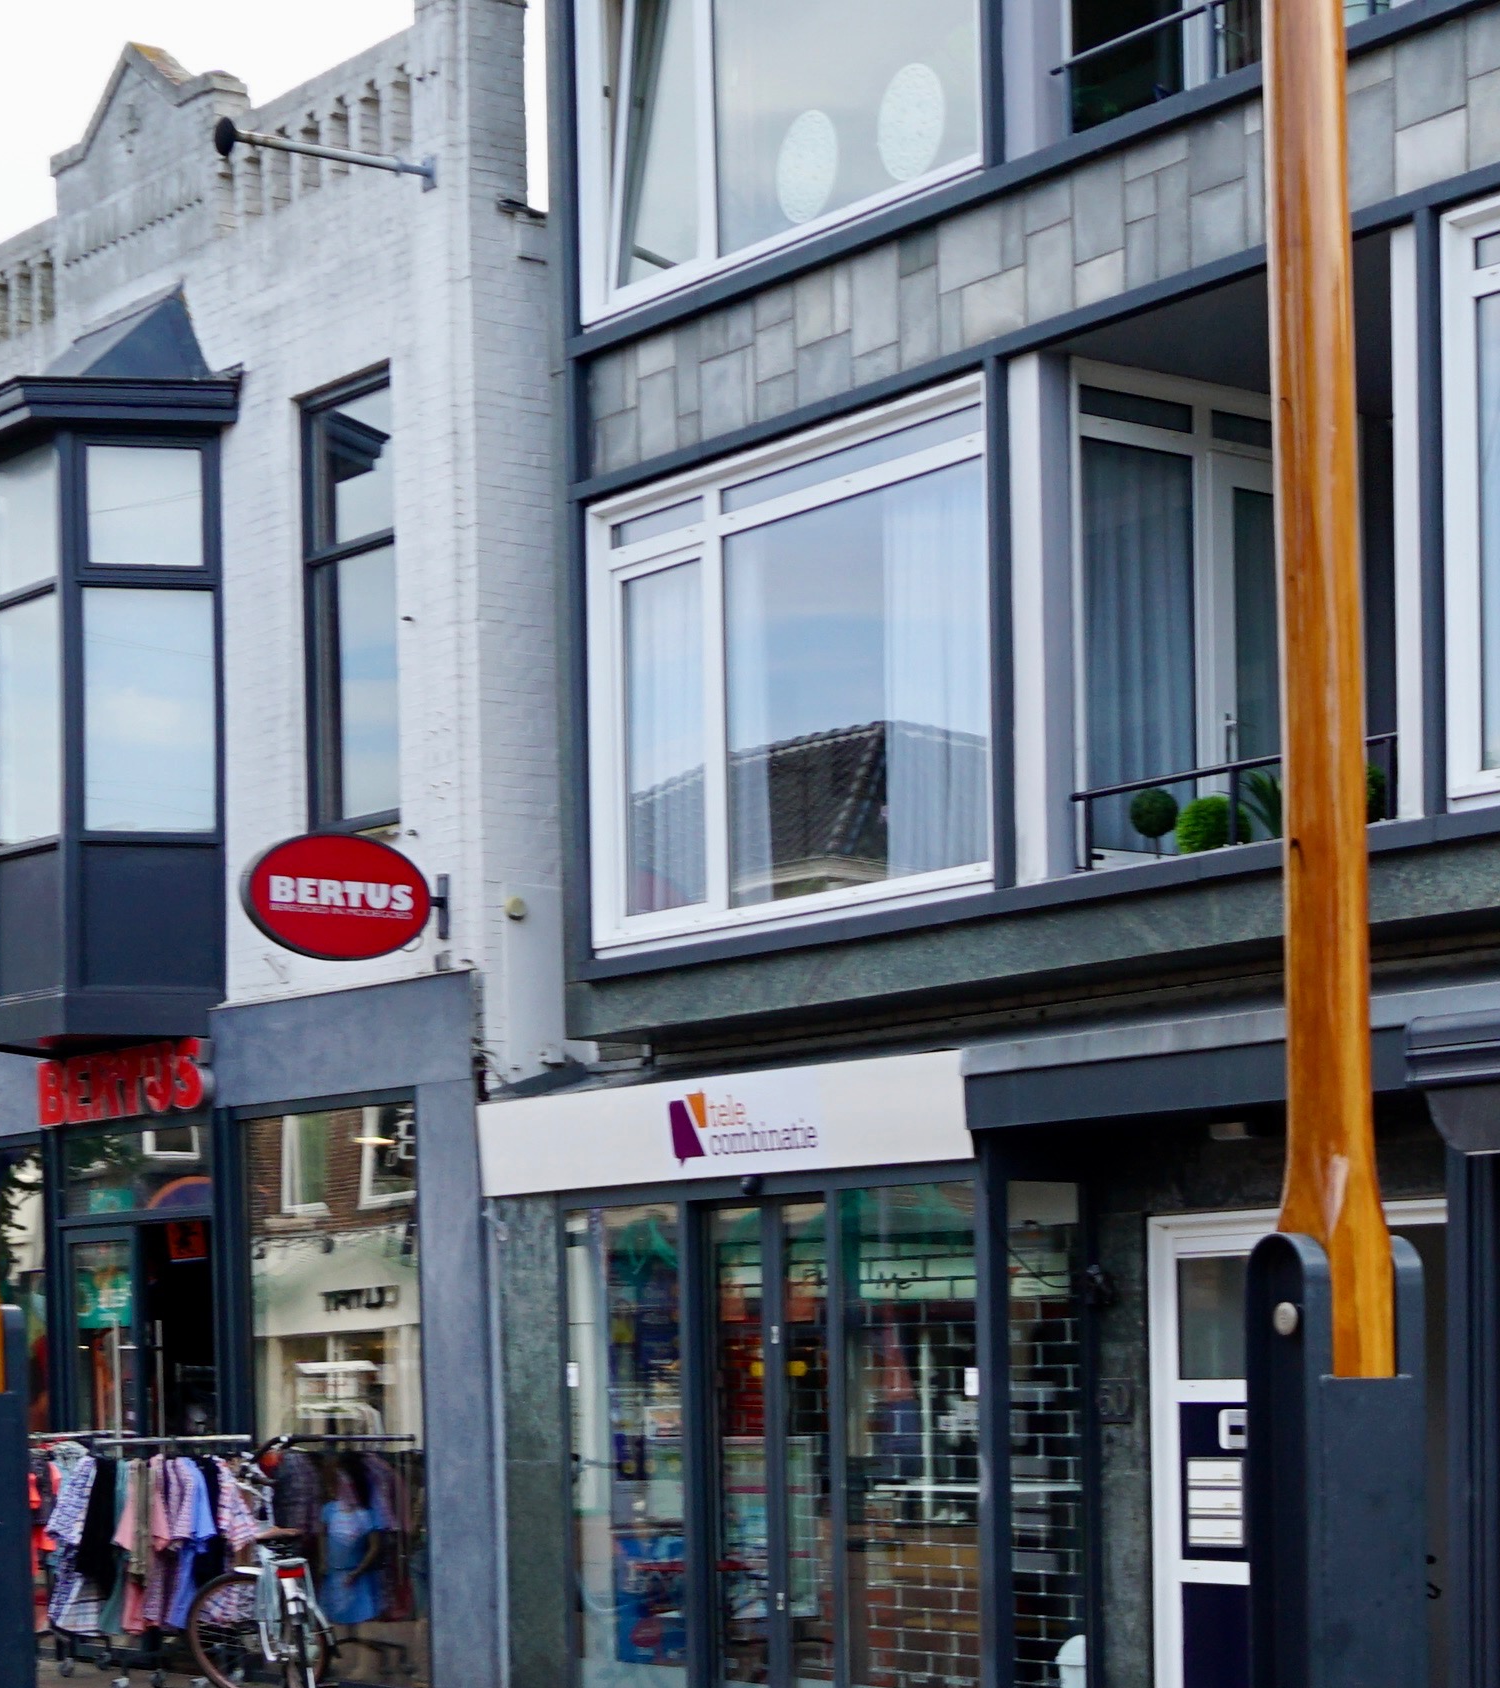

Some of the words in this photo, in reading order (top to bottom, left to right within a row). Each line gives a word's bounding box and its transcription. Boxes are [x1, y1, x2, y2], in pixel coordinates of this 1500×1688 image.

[269, 874, 414, 911] BERTUS
[37, 1036, 213, 1127] BERTUS
[708, 1094, 746, 1127] tele
[710, 1118, 818, 1156] combinatie
